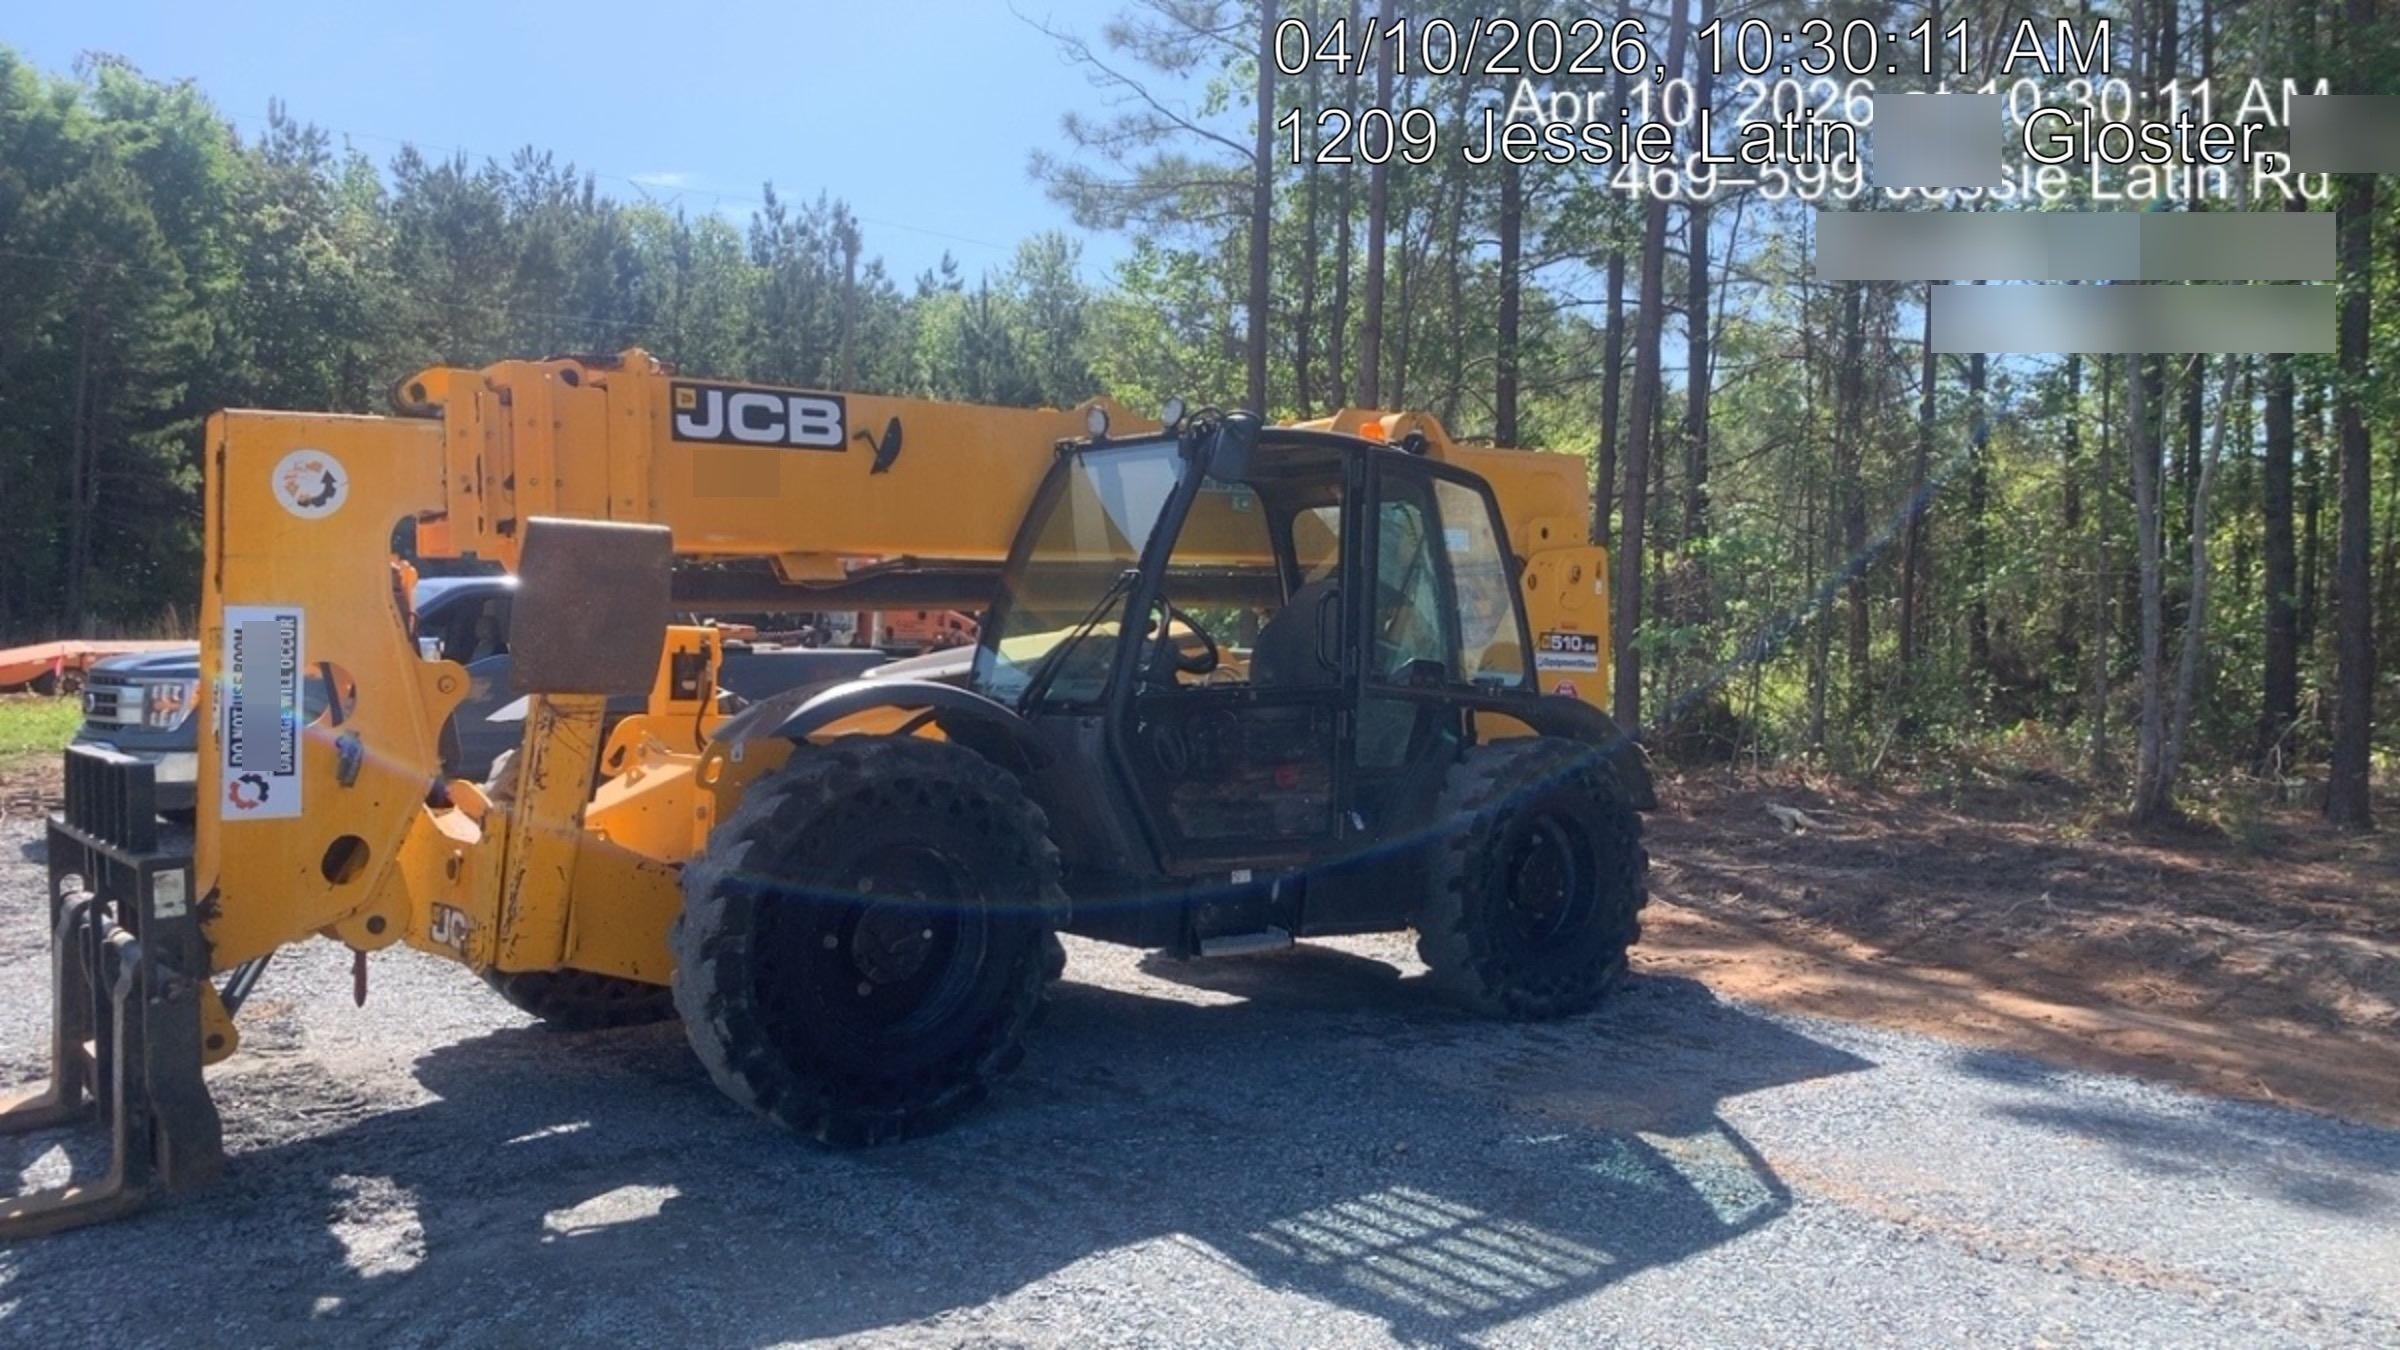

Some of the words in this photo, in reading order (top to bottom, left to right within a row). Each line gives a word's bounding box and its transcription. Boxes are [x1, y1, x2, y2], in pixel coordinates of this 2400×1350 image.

[676, 389, 844, 446] JCB
[281, 618, 297, 669] OCCUR
[281, 671, 296, 707] WILL
[281, 710, 296, 773] DAMAGE
